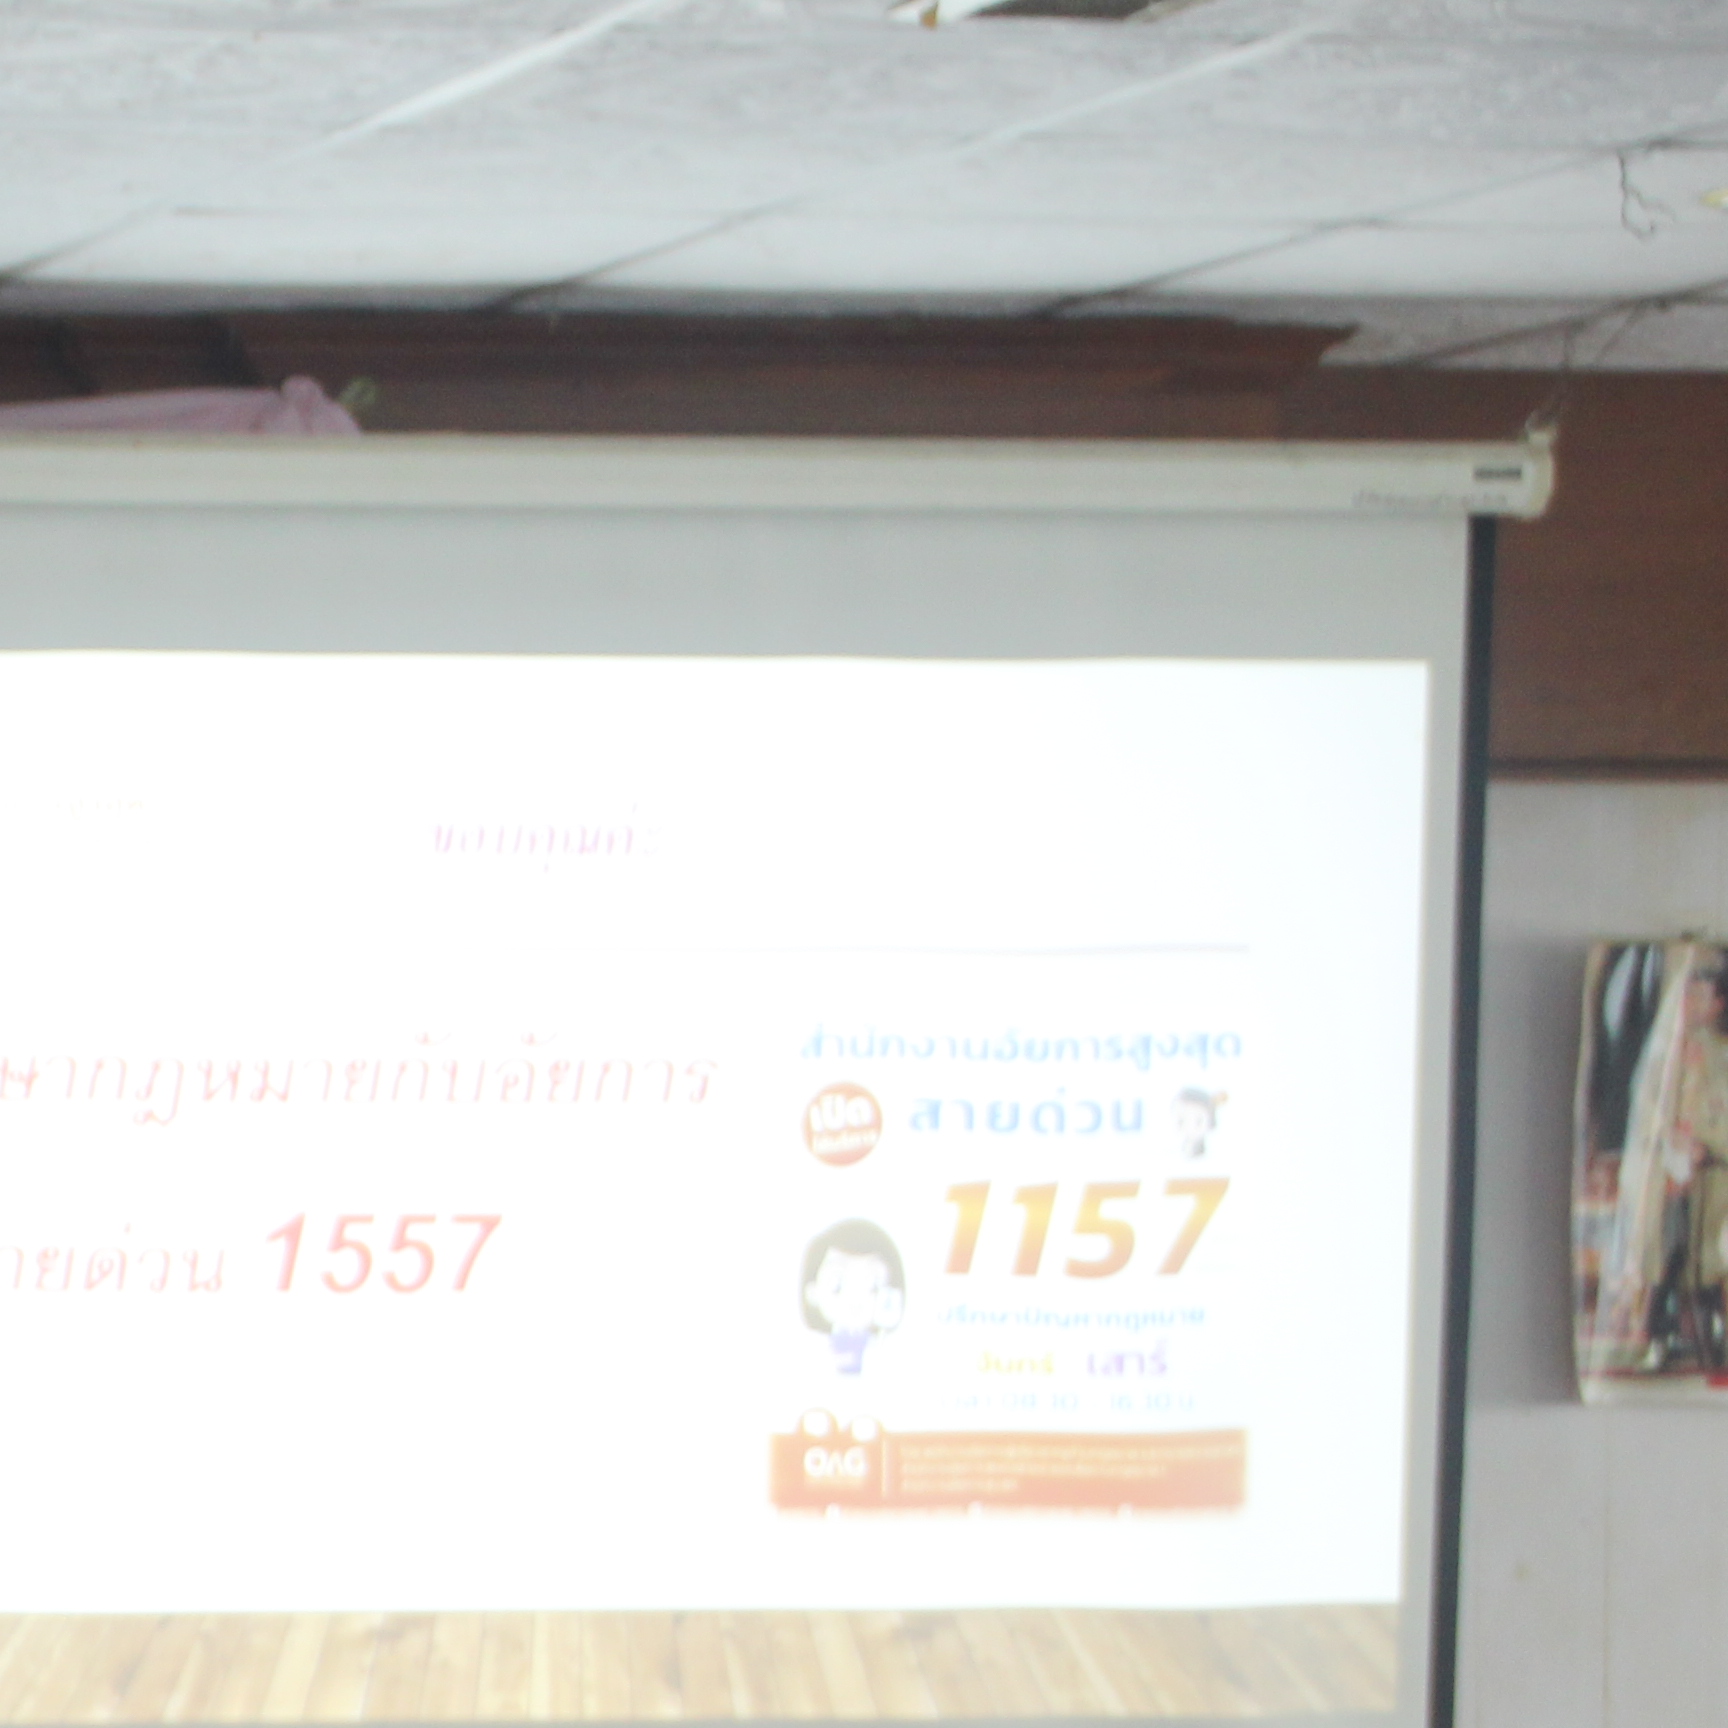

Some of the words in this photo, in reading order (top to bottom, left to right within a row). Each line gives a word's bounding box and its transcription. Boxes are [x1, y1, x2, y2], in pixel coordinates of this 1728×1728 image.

[800, 1022, 1245, 1072] สำนักงานอัยการสูงสุด
[907, 1086, 1145, 1136] สายด่วน
[263, 1211, 503, 1297] 1557
[941, 1175, 1232, 1280] 1157
